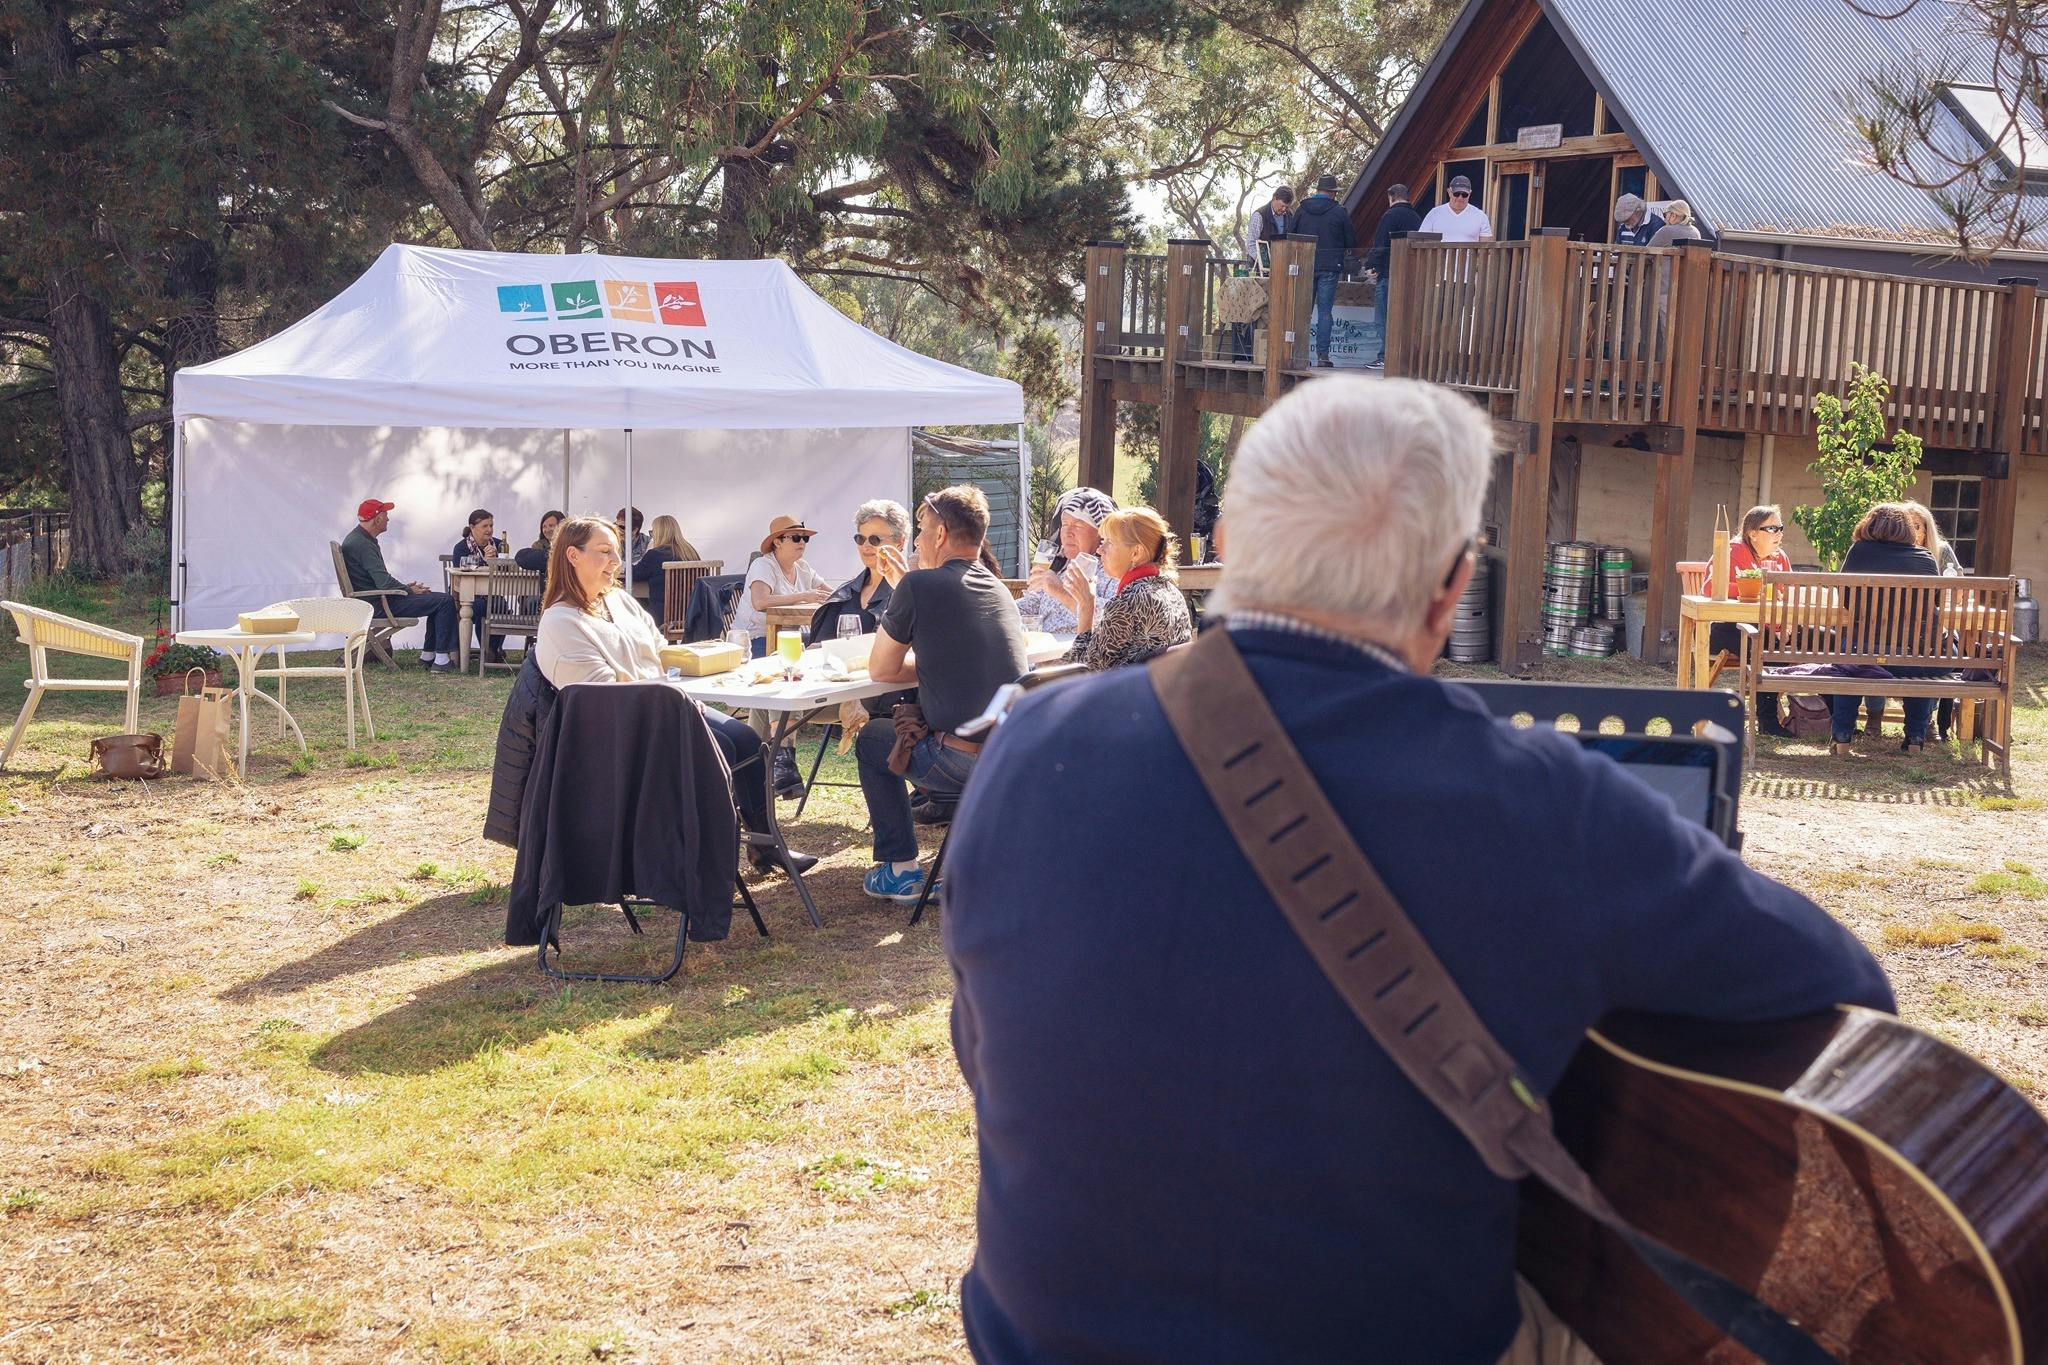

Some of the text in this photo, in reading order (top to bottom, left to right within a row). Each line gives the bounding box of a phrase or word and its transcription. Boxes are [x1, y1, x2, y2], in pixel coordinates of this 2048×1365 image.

[1311, 318, 1362, 337] BURST
[506, 332, 717, 359] OBERON
[1311, 344, 1358, 354] DILLERY
[510, 359, 721, 374] MORE THAN YOU IMAGINE
